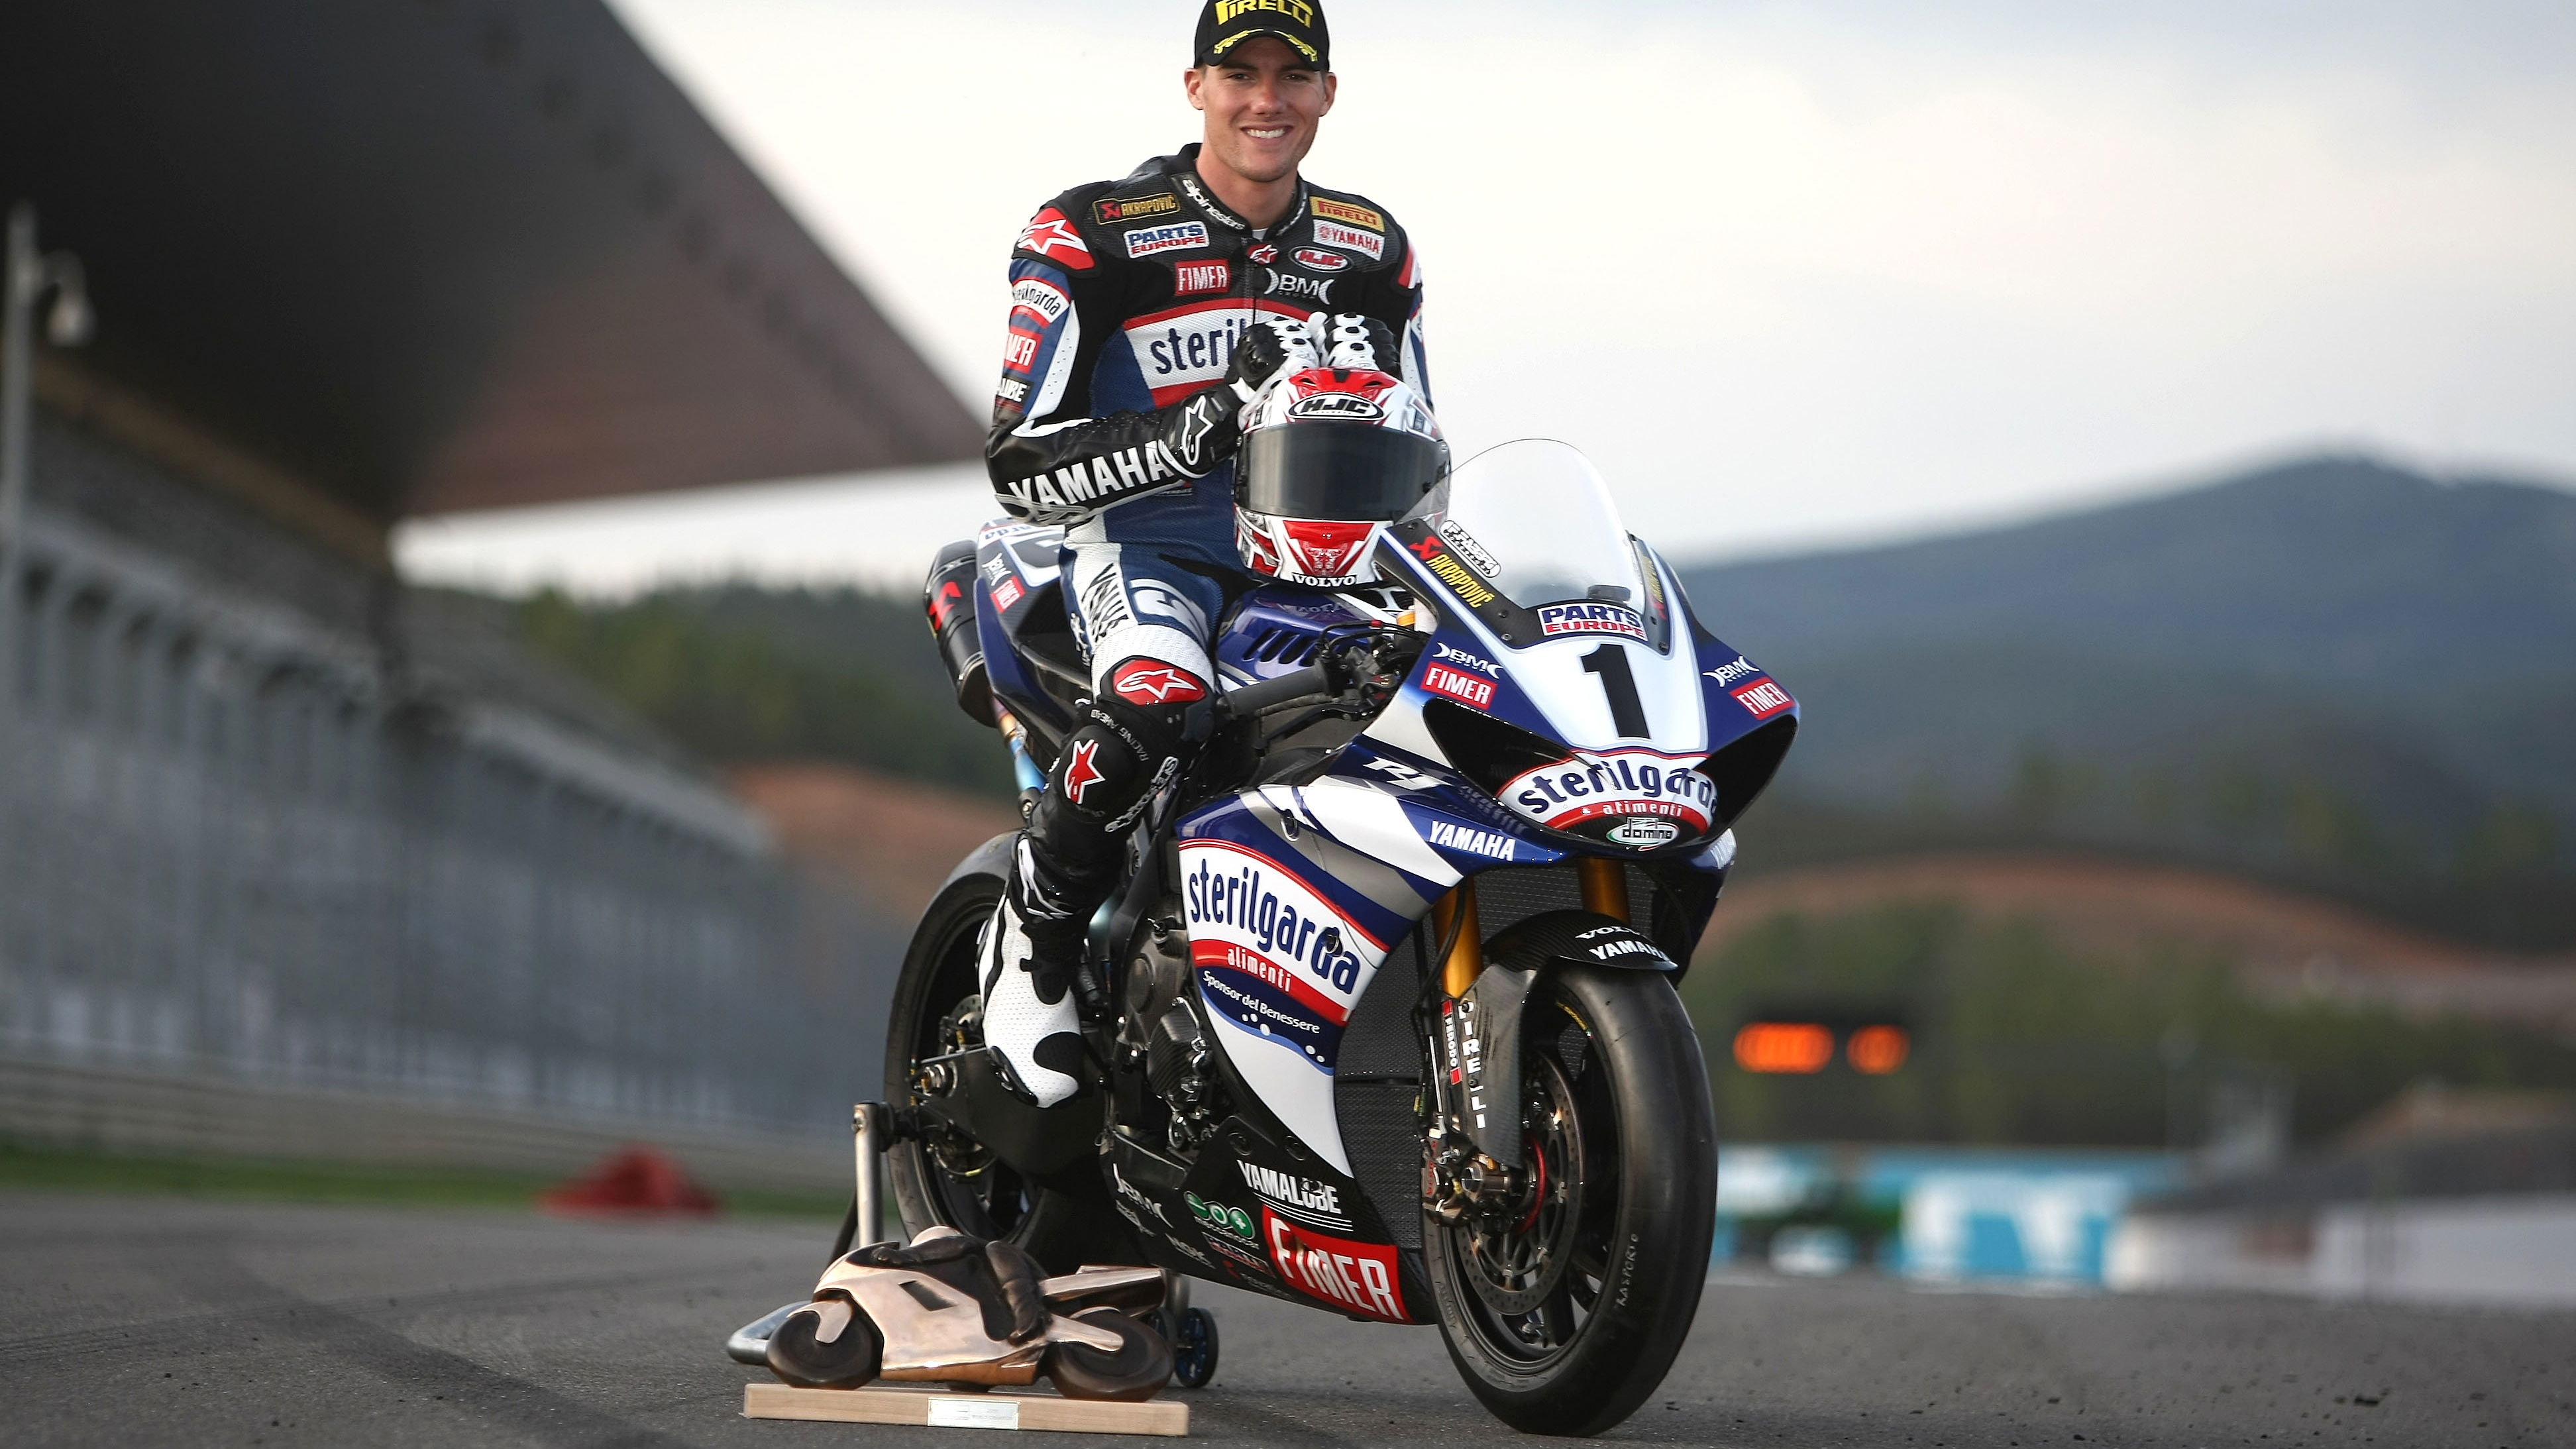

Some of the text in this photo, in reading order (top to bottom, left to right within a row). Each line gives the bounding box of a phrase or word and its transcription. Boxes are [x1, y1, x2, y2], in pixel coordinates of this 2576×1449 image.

[1183, 180, 1246, 230] alpinestars
[1317, 201, 1377, 225] PIRELLI
[1128, 225, 1203, 246] PARTS
[1132, 237, 1206, 254] EUROPE
[1333, 229, 1380, 254] YAMAHA
[1298, 249, 1344, 267] HJC
[1179, 265, 1228, 292] FIMER
[1300, 399, 1371, 414] HJC
[1008, 439, 1175, 506] YAMAHA
[1293, 575, 1356, 587] VOLVO
[1542, 606, 1641, 627] PARTS
[1545, 621, 1645, 638] EUROPE
[1426, 667, 1491, 704] FIMER
[1580, 643, 1652, 739] 1
[1737, 683, 1790, 715] FIMER
[1430, 820, 1516, 861] YAMAHA
[1189, 859, 1360, 995] sterilgarda
[1227, 947, 1292, 993] alimenti
[1203, 970, 1320, 1034] Sponsor del Benessere
[1445, 1017, 1458, 1068] FERODO
[1270, 1216, 1404, 1320] FIMER
